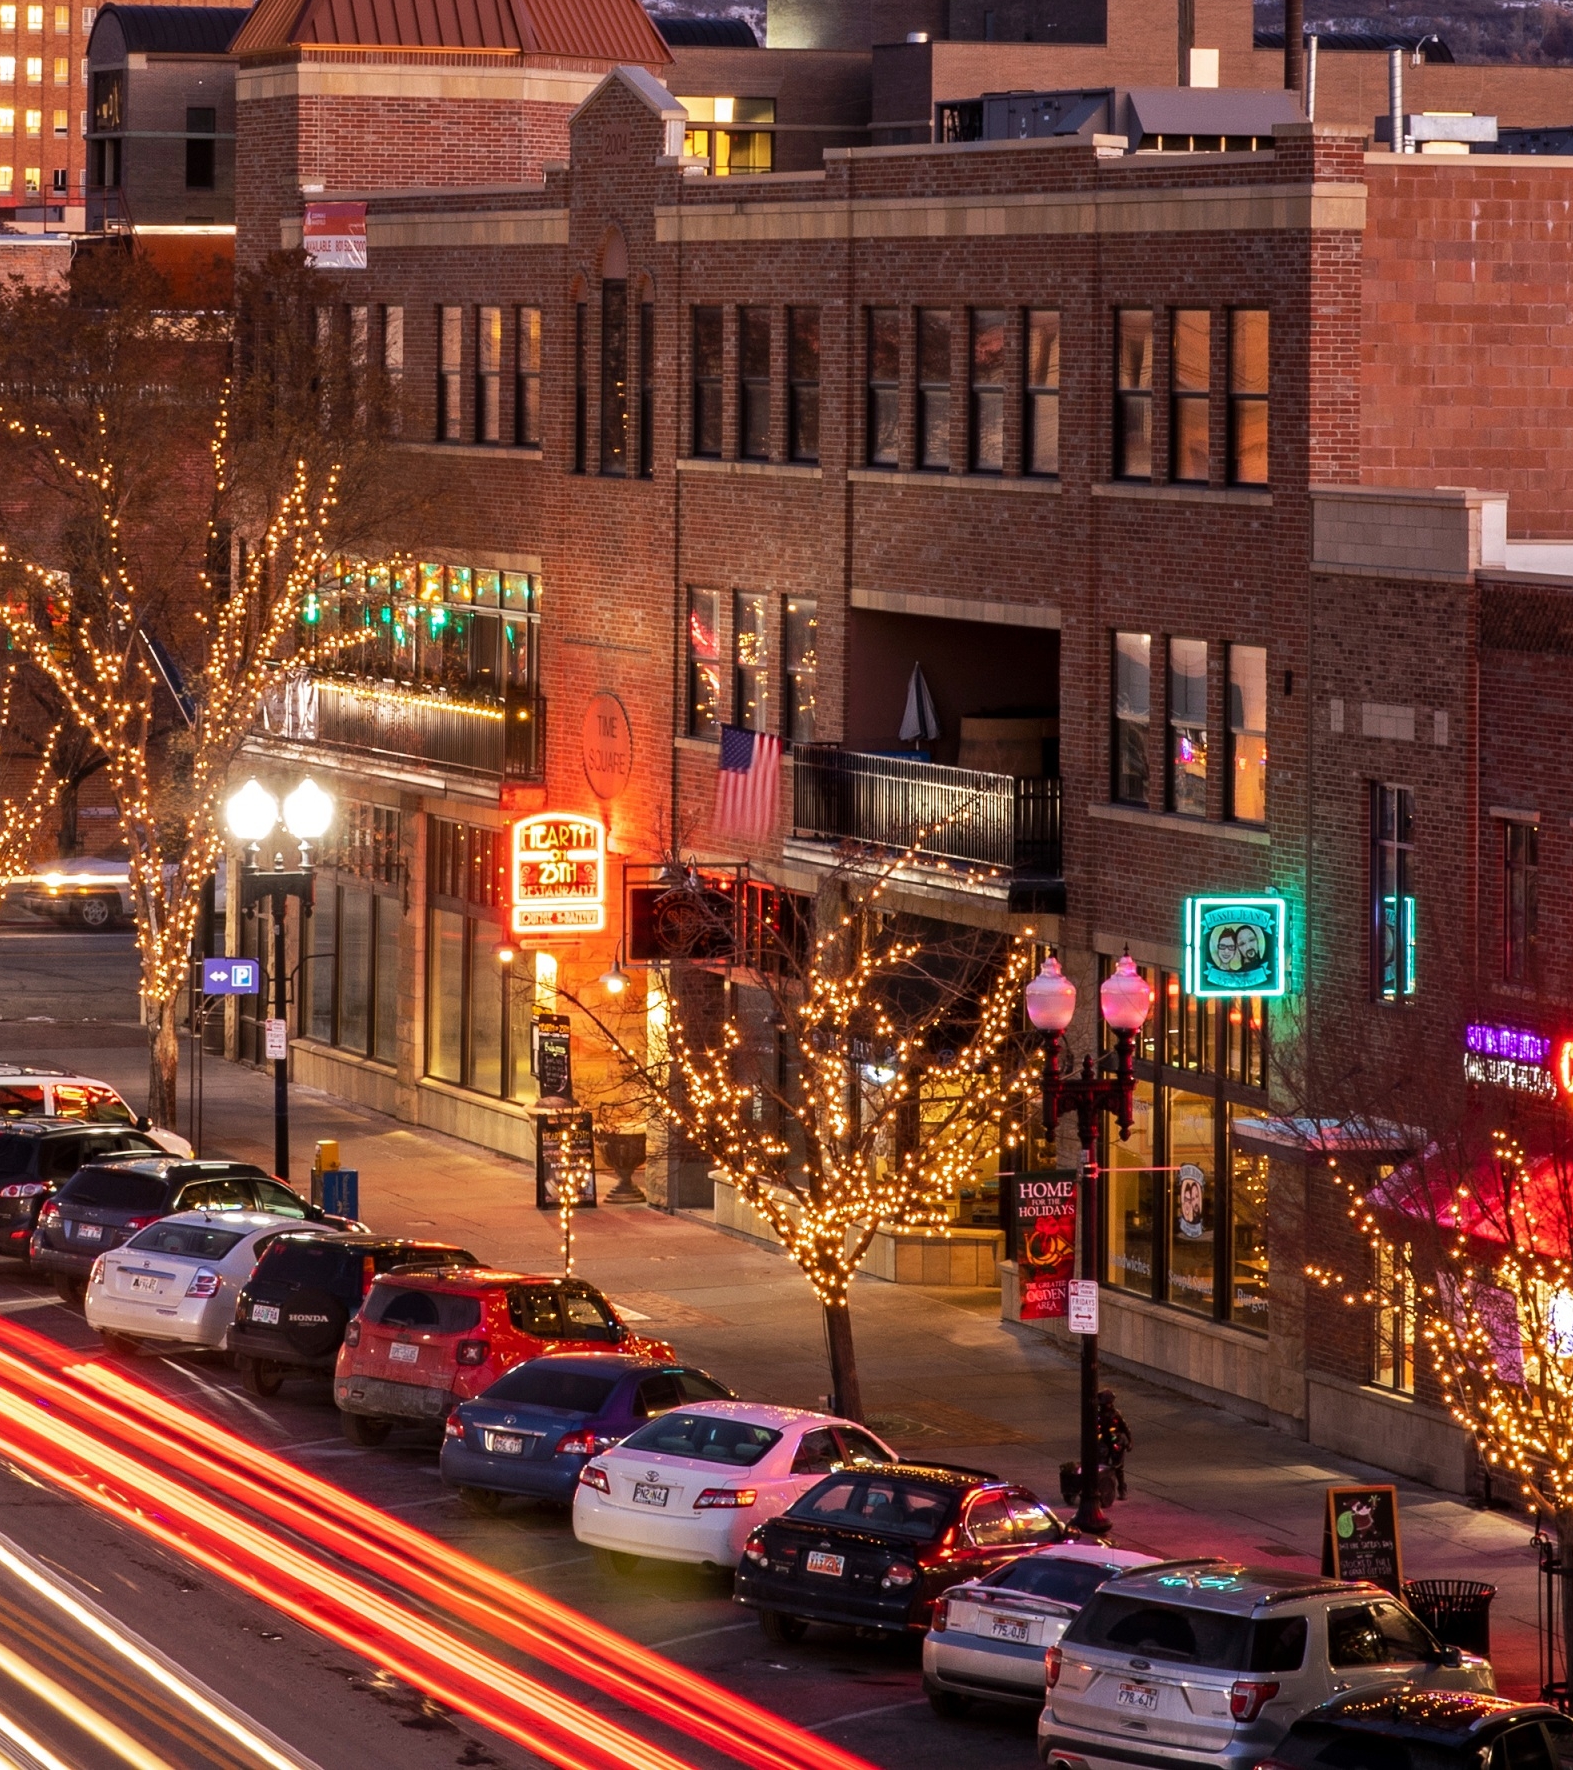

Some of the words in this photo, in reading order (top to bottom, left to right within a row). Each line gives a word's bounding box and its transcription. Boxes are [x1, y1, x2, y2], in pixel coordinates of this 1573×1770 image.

[605, 133, 628, 156] 2004
[597, 714, 618, 739] TIME
[588, 750, 626, 776] SQUARE
[519, 823, 596, 849] HEARTH
[539, 862, 577, 884] 25TH
[520, 884, 597, 899] RESTAURANT
[1206, 911, 1236, 925] JESSIE
[1238, 909, 1269, 925] JEAN'S
[236, 967, 249, 984] P
[1019, 1181, 1073, 1199] HOME
[1032, 1198, 1046, 1206] FOR
[1019, 1204, 1075, 1218] HOLIDAYS
[1026, 1288, 1067, 1303] OGDEN
[1071, 1297, 1095, 1307] FRIDAYS
[1237, 1287, 1270, 1314] Burgers
[1036, 1301, 1057, 1311] AREA
[288, 1313, 329, 1323] HONDA
